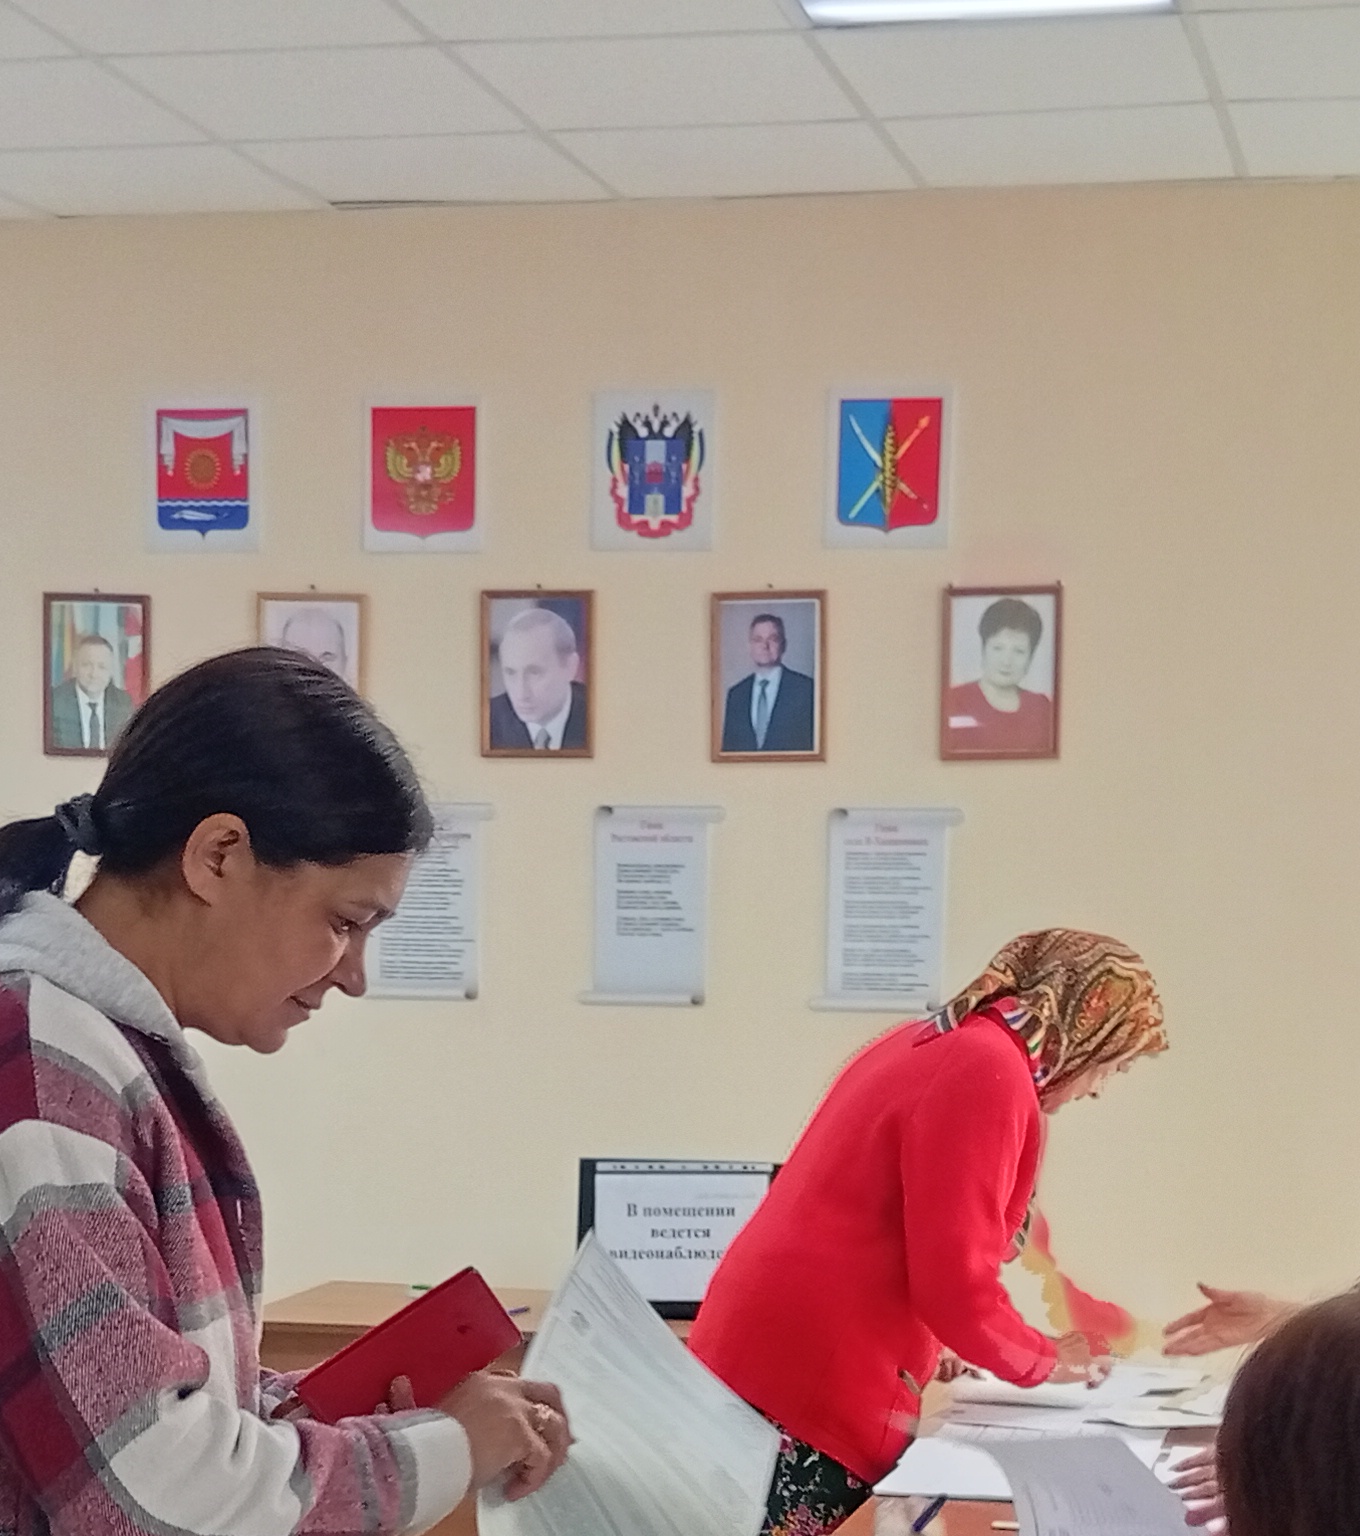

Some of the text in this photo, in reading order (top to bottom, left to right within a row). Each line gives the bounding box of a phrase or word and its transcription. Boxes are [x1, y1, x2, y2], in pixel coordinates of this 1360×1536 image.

[627, 1203, 736, 1219] В помещении
[650, 1227, 711, 1239] ведется
